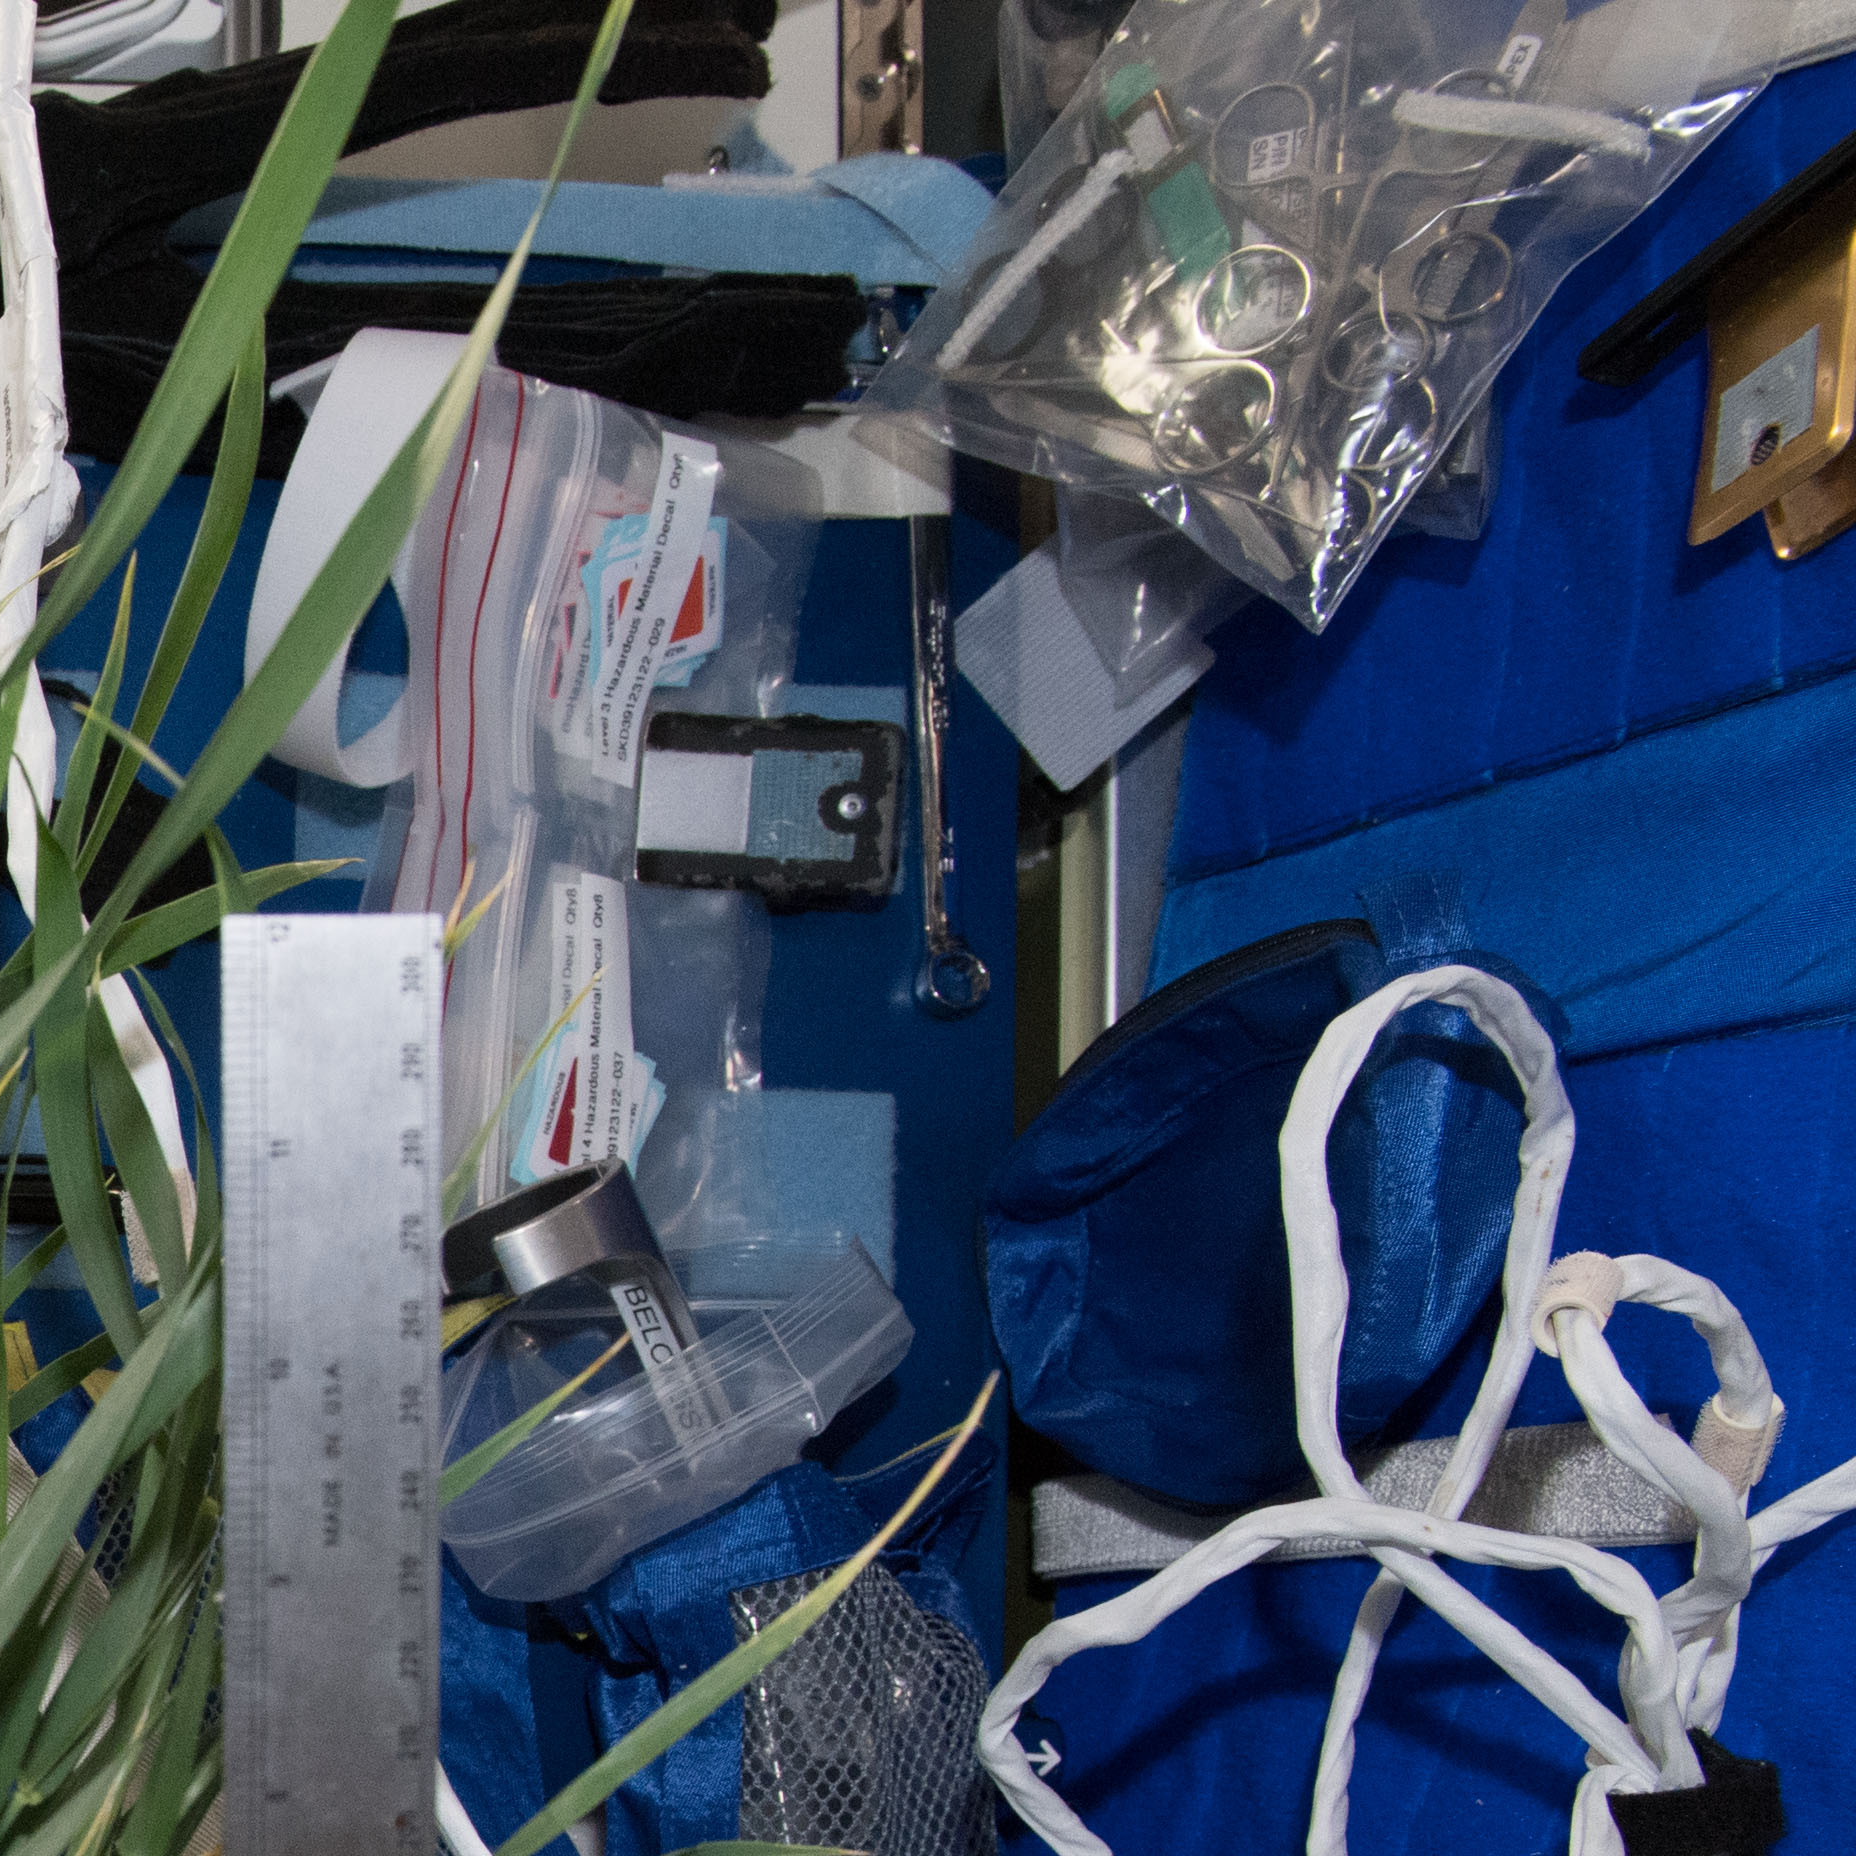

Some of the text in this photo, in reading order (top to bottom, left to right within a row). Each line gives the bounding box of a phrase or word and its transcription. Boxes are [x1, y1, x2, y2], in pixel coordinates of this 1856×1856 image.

[655, 499, 677, 547] Decal
[635, 549, 664, 612] Material
[603, 615, 642, 699] Hazardous
[600, 702, 612, 713] 3
[566, 888, 576, 925] Qty8
[593, 894, 603, 928] Qty8
[588, 987, 604, 1048] Material
[543, 1072, 565, 1136] HAZARDOUS
[583, 1053, 601, 1134] Hazardous
[582, 1140, 592, 1148] 4
